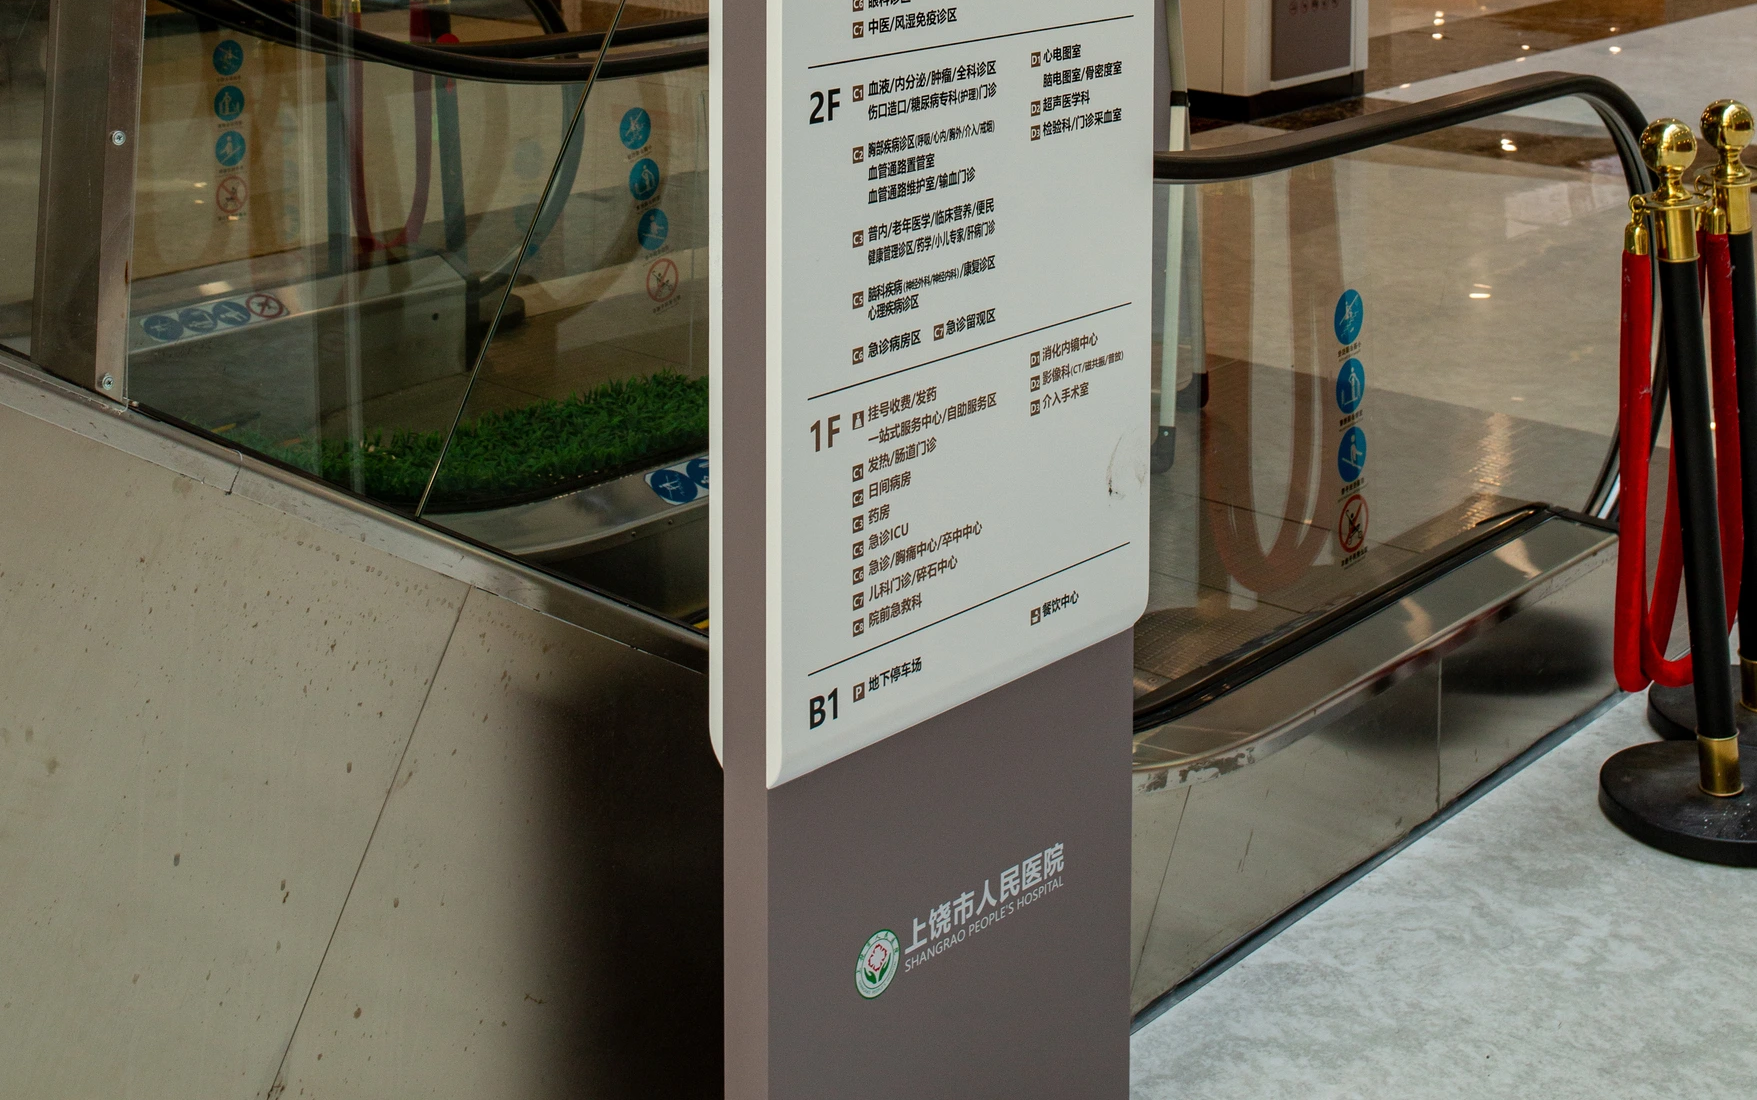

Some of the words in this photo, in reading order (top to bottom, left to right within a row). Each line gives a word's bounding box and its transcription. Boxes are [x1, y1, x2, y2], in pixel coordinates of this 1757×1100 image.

[853, 22, 864, 38] C7
[868, 7, 958, 35] 中医/风湿免疫诊区
[1031, 53, 1041, 66] D1
[1043, 44, 1082, 64] 心电图室
[853, 86, 864, 101] C1
[868, 60, 997, 96] 血液/内分泌/肿瘤/全科诊区
[1043, 61, 1122, 88] 脑电图室/骨密度室
[809, 88, 841, 125] 2F
[1031, 102, 1041, 115] D2
[1043, 89, 1090, 113] 超声医学科
[1031, 126, 1041, 140] D3
[1043, 108, 1122, 137] 检验科/门诊采血室
[853, 147, 864, 163] C2
[868, 153, 935, 181] 血管通路置管室
[868, 166, 976, 204] 血管通路维护室/输血门诊
[852, 231, 864, 247] C3
[852, 292, 864, 308] C5
[868, 293, 919, 321] 心理疾病诊区
[852, 348, 864, 364] C6
[868, 329, 921, 358] 急诊病房区
[934, 324, 944, 340] C7
[946, 308, 996, 336] 急诊留观区
[1031, 352, 1040, 367] D1
[1042, 332, 1098, 361] 消化内镜中心
[1031, 376, 1040, 391] D2
[1031, 400, 1040, 415] D3
[1043, 381, 1089, 410] 介入手术室
[868, 386, 937, 422] 挂号收费/发药
[868, 392, 997, 444] 一站式服务中心/自助服务区
[810, 414, 841, 452] 1F
[852, 464, 864, 482] C1
[868, 436, 937, 473] 发热/肠道门诊
[852, 490, 864, 507] C2
[868, 471, 911, 499] 日间病房
[852, 515, 864, 533] C3
[868, 504, 890, 525] 药房
[853, 541, 864, 559] C5
[868, 522, 909, 550] 急诊ICU
[853, 566, 864, 584] C6
[868, 520, 983, 576] 急诊/胸痛中心/卒中中心
[853, 592, 864, 610] C7
[868, 555, 958, 602] 儿科门诊/碎石中心
[853, 618, 864, 636] C8
[869, 593, 923, 628] 院前急救科
[1042, 590, 1079, 617] 餐饮中心
[868, 656, 922, 692] 地下停车场
[809, 687, 838, 730] B1
[905, 843, 1064, 955] 上饶市人民医院
[905, 930, 965, 973] SHANGRAO
[969, 902, 1014, 936] PEOPLE'S
[1017, 876, 1064, 910] HOSPITAL
